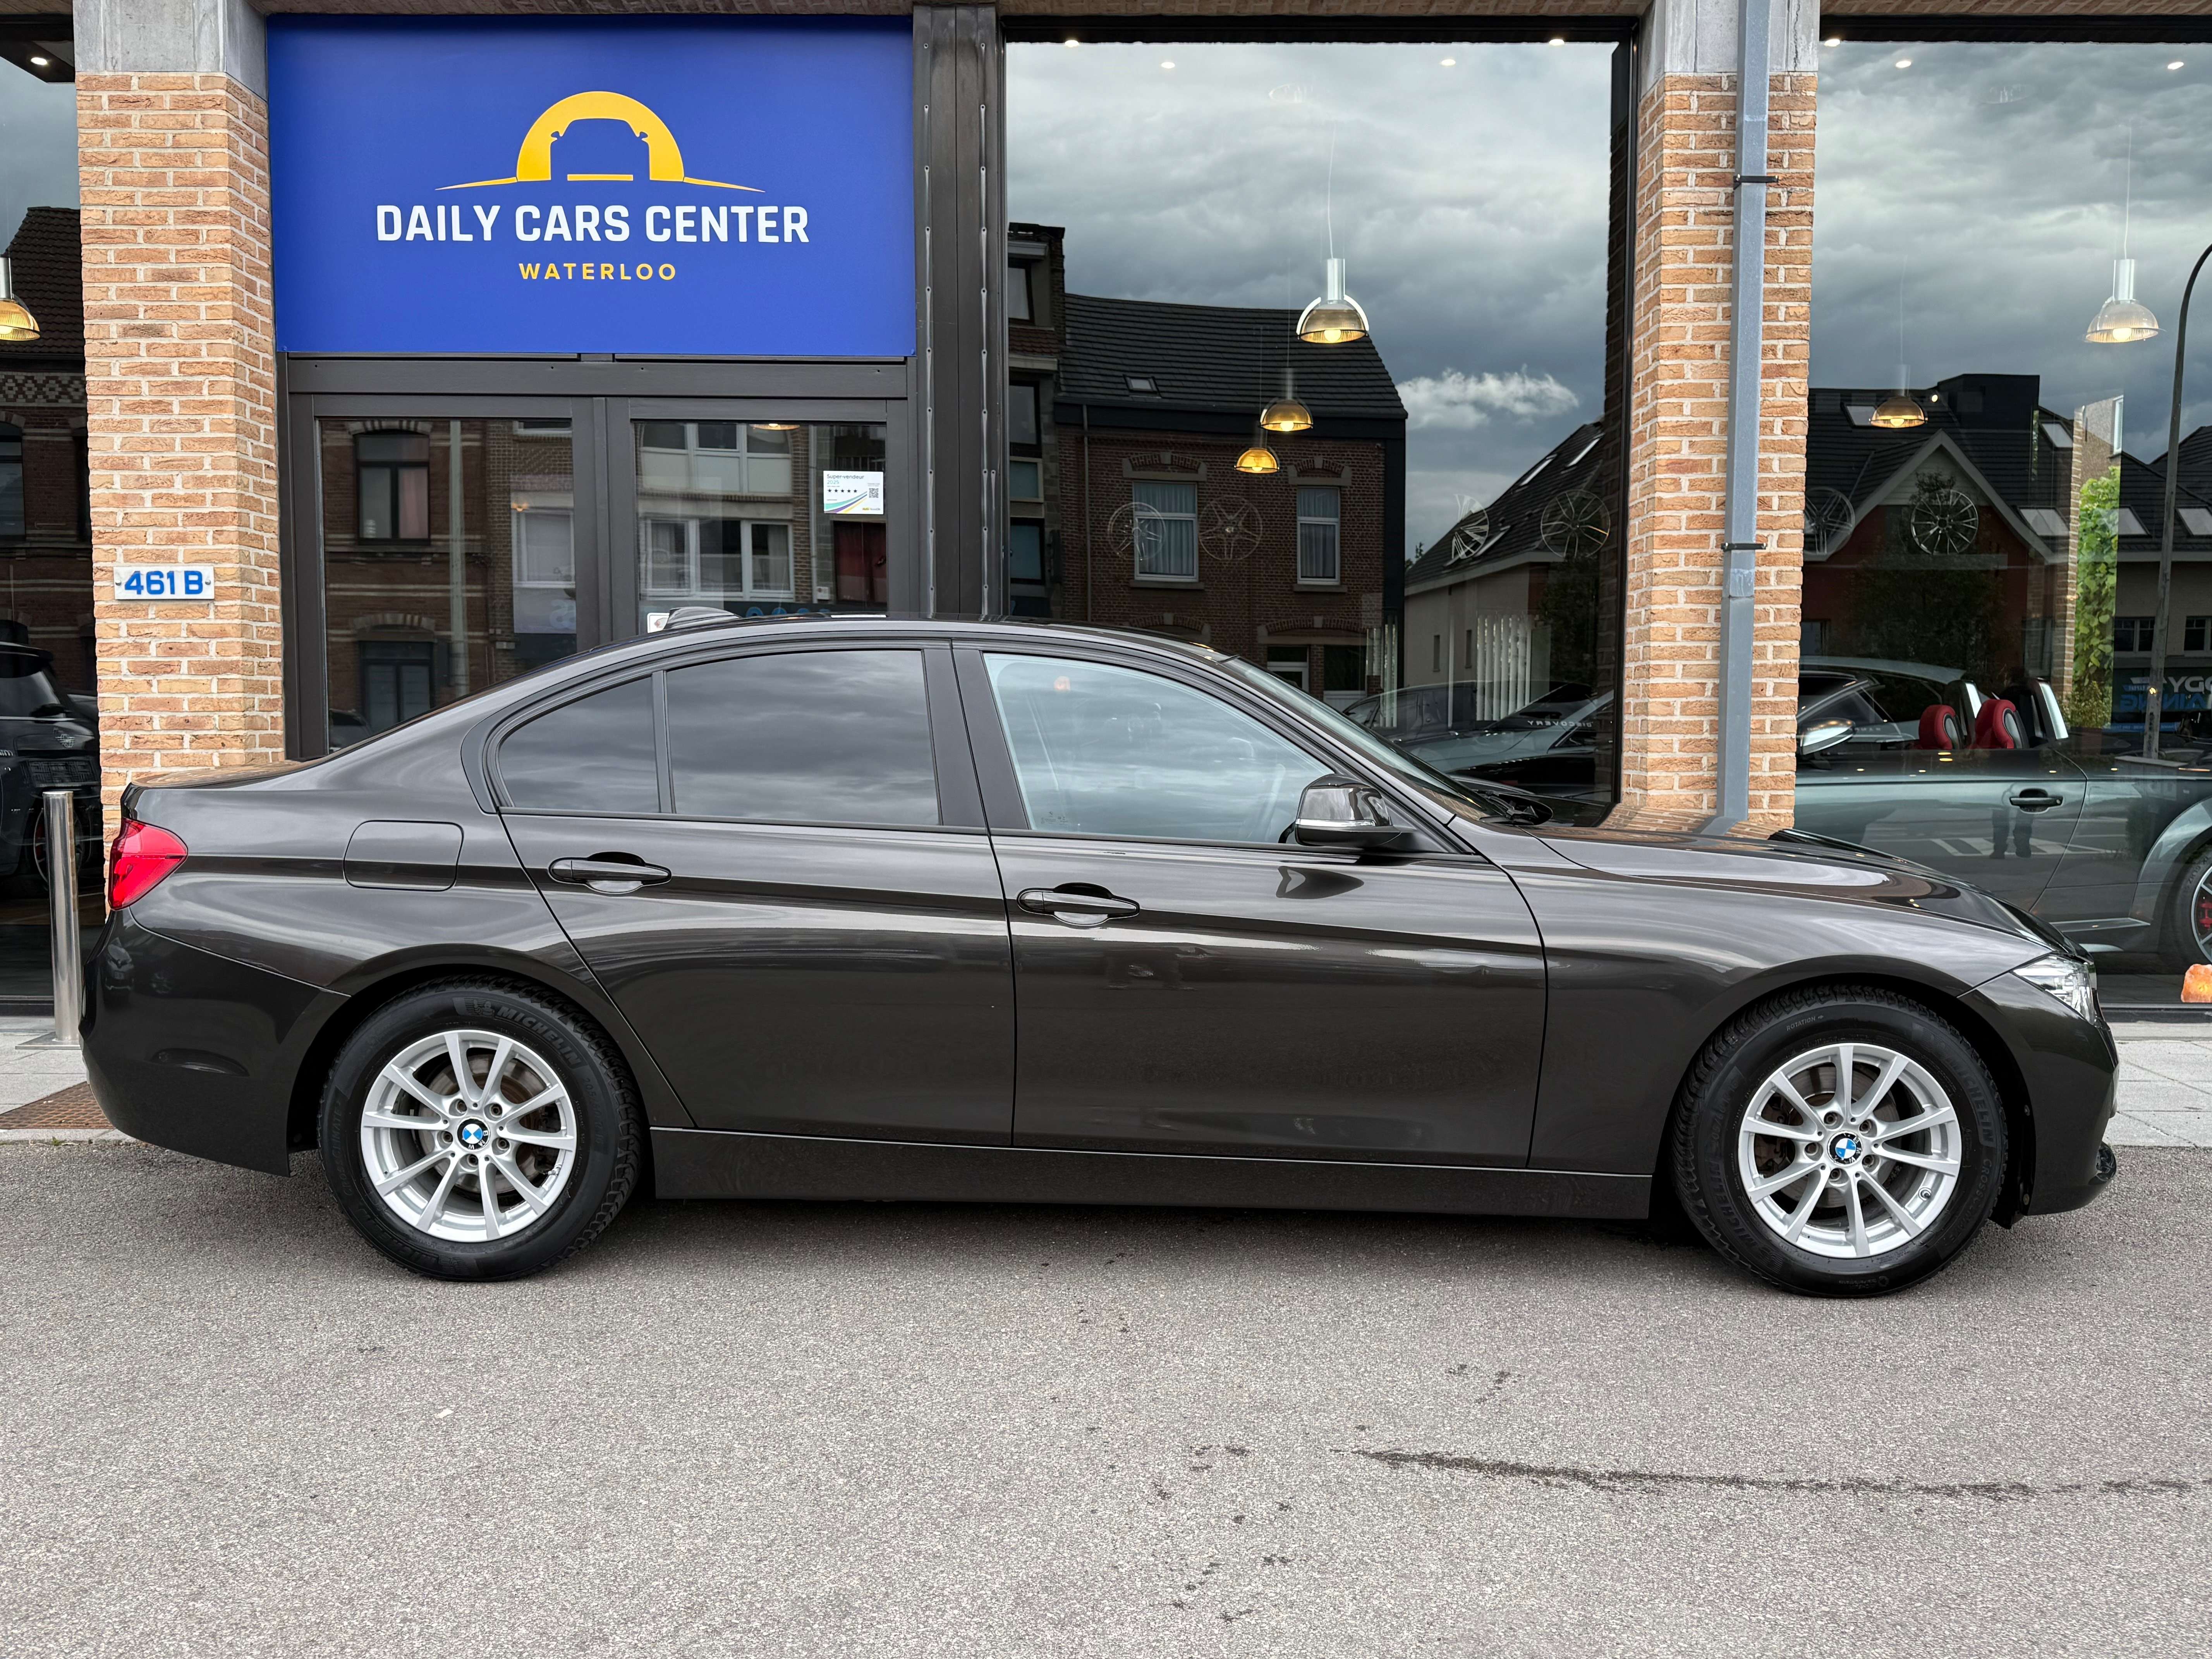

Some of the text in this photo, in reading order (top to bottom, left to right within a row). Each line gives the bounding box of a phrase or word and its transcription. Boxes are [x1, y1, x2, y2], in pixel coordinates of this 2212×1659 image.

[376, 204, 810, 243] DAILY CARS CENTER
[518, 263, 676, 281] WATERLOO
[124, 570, 204, 595] 461 B
[497, 1007, 581, 1065] MICHELIN
[1786, 1015, 1816, 1032] ROTATION
[1945, 1056, 1994, 1142] MICHELIN
